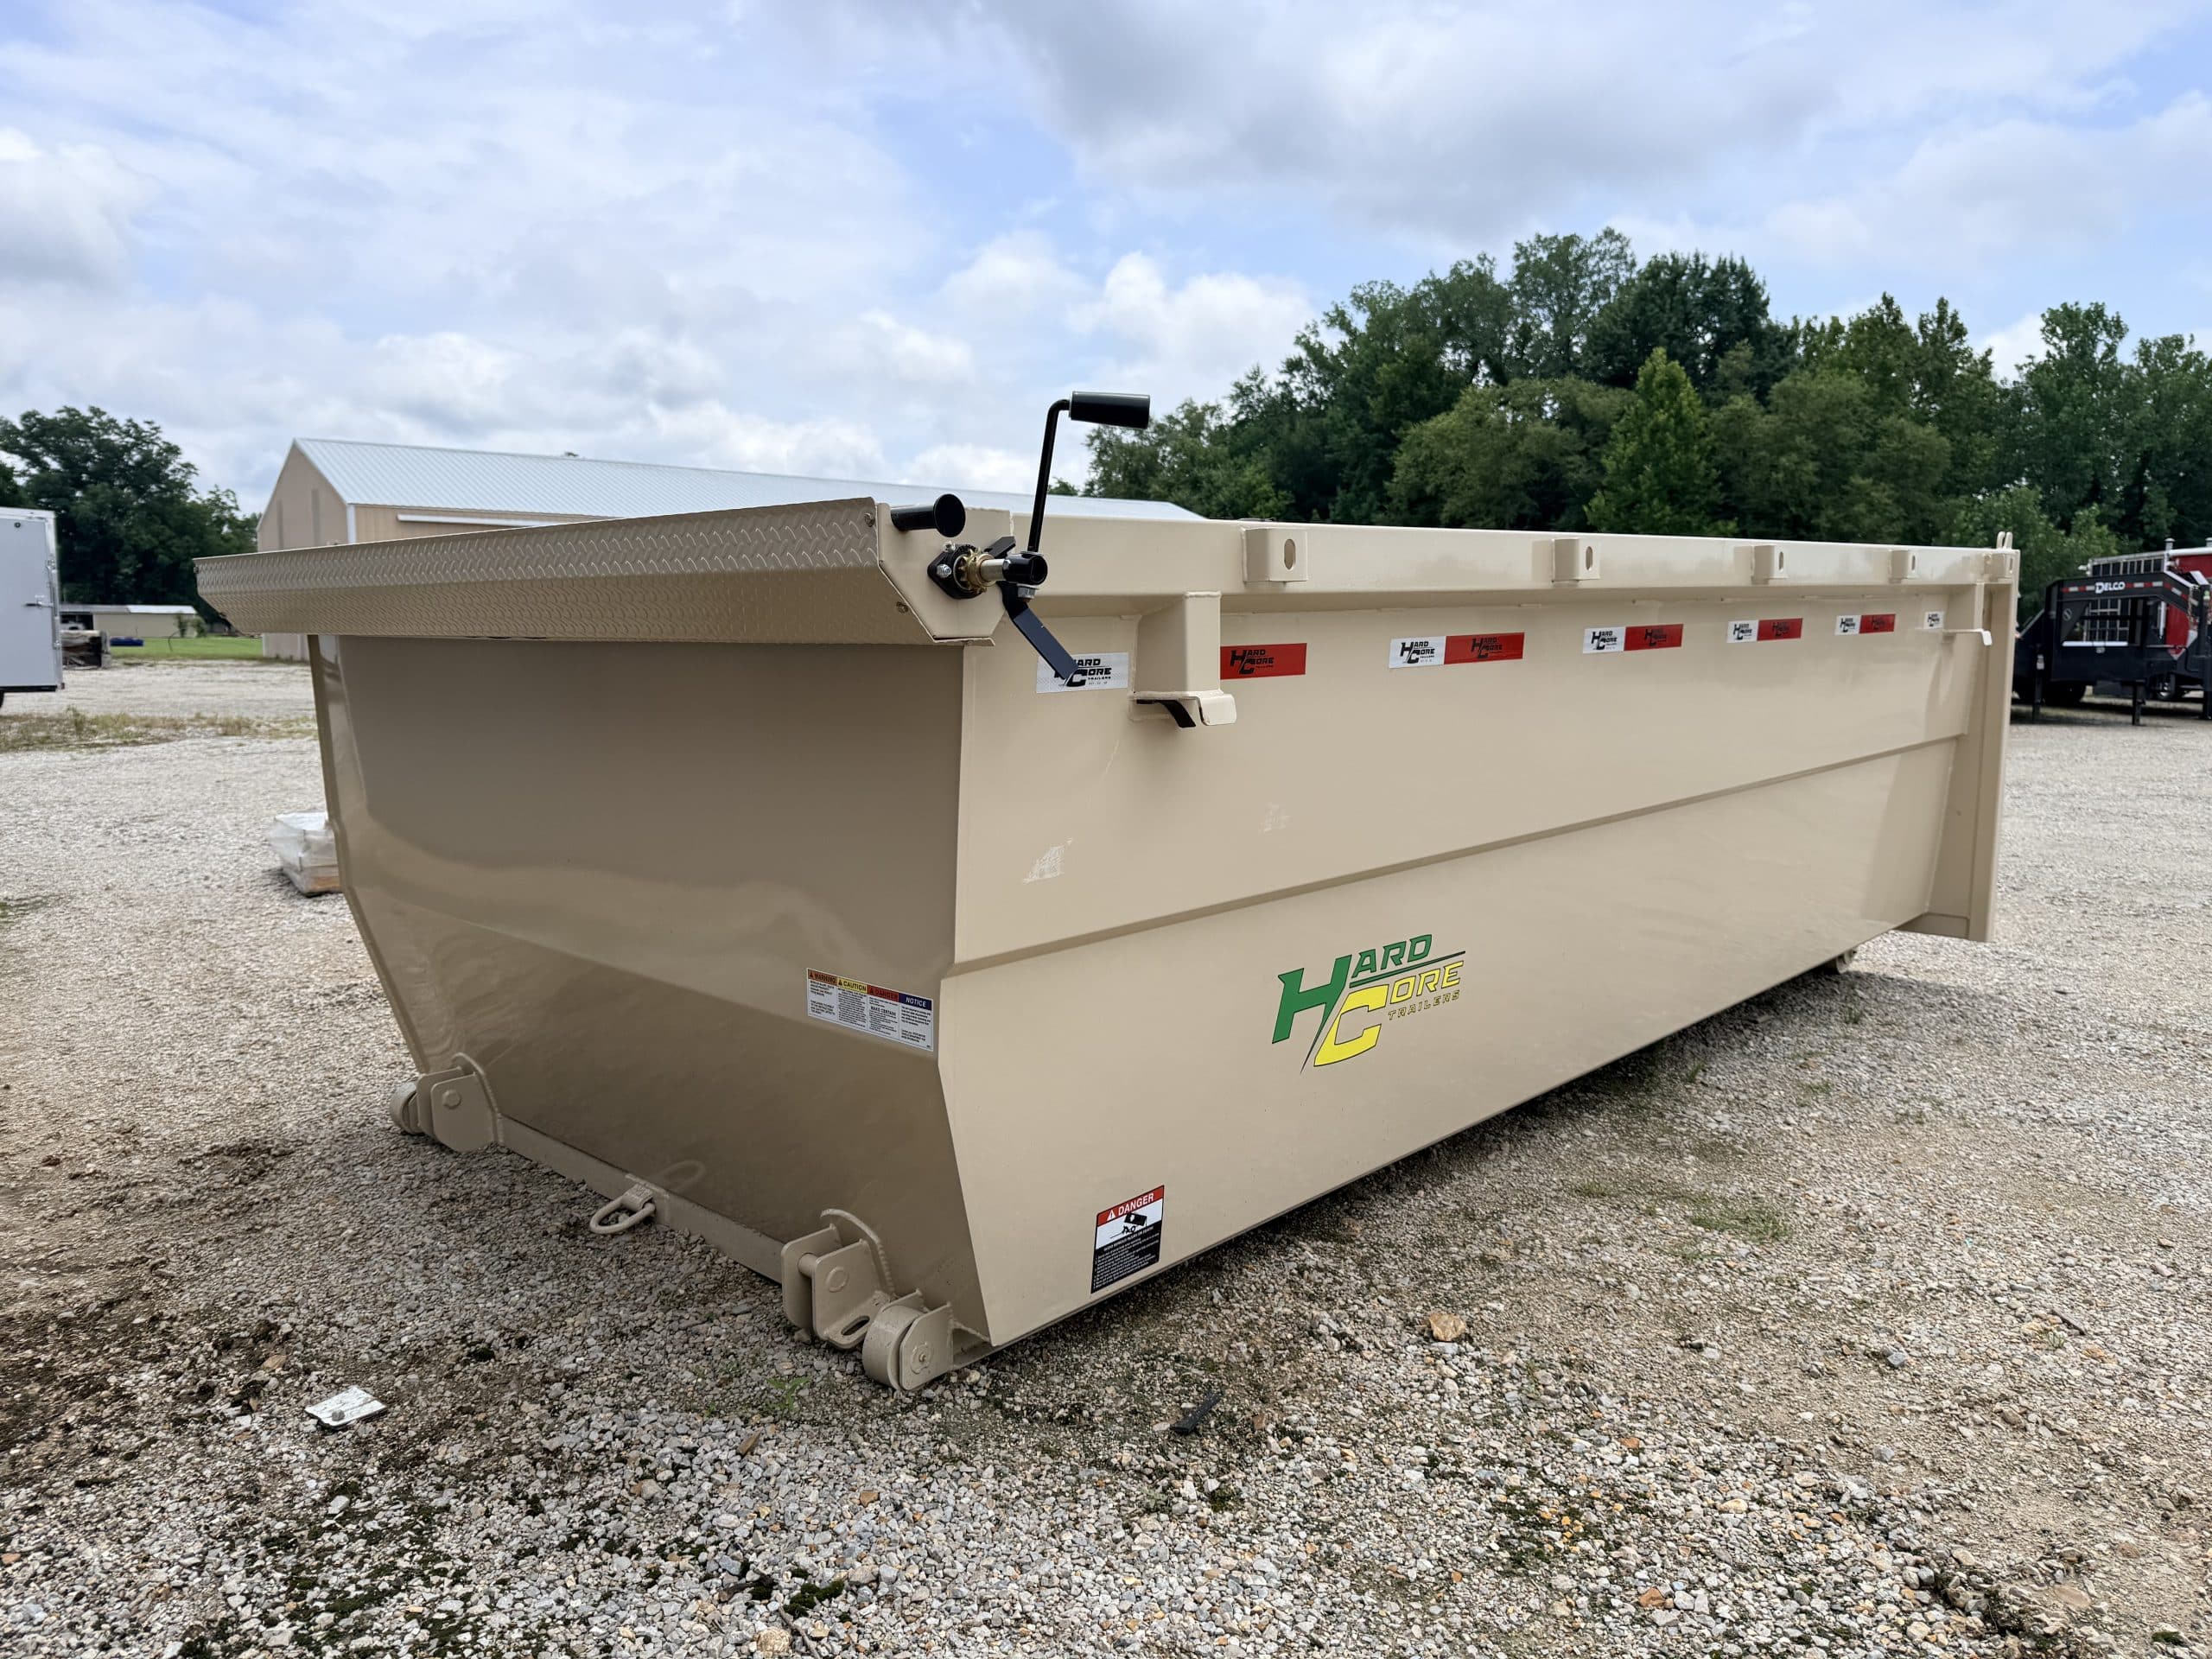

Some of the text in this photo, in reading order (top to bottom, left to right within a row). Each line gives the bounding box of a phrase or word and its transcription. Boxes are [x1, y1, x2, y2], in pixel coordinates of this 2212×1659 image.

[2094, 582, 2126, 594] DELCO
[1400, 640, 1429, 657] HARD
[1407, 648, 1435, 664] CORE
[1230, 649, 1266, 667] HARD
[1239, 657, 1274, 675] CORE
[1066, 667, 1112, 688] CORE
[843, 981, 867, 992] CAUTION
[1272, 934, 1433, 1046] HARD
[906, 996, 927, 1007] NOTICE
[1388, 989, 1460, 1021] TRAILERS
[1313, 960, 1465, 1067] CORE
[1118, 1192, 1154, 1216] DANGER
